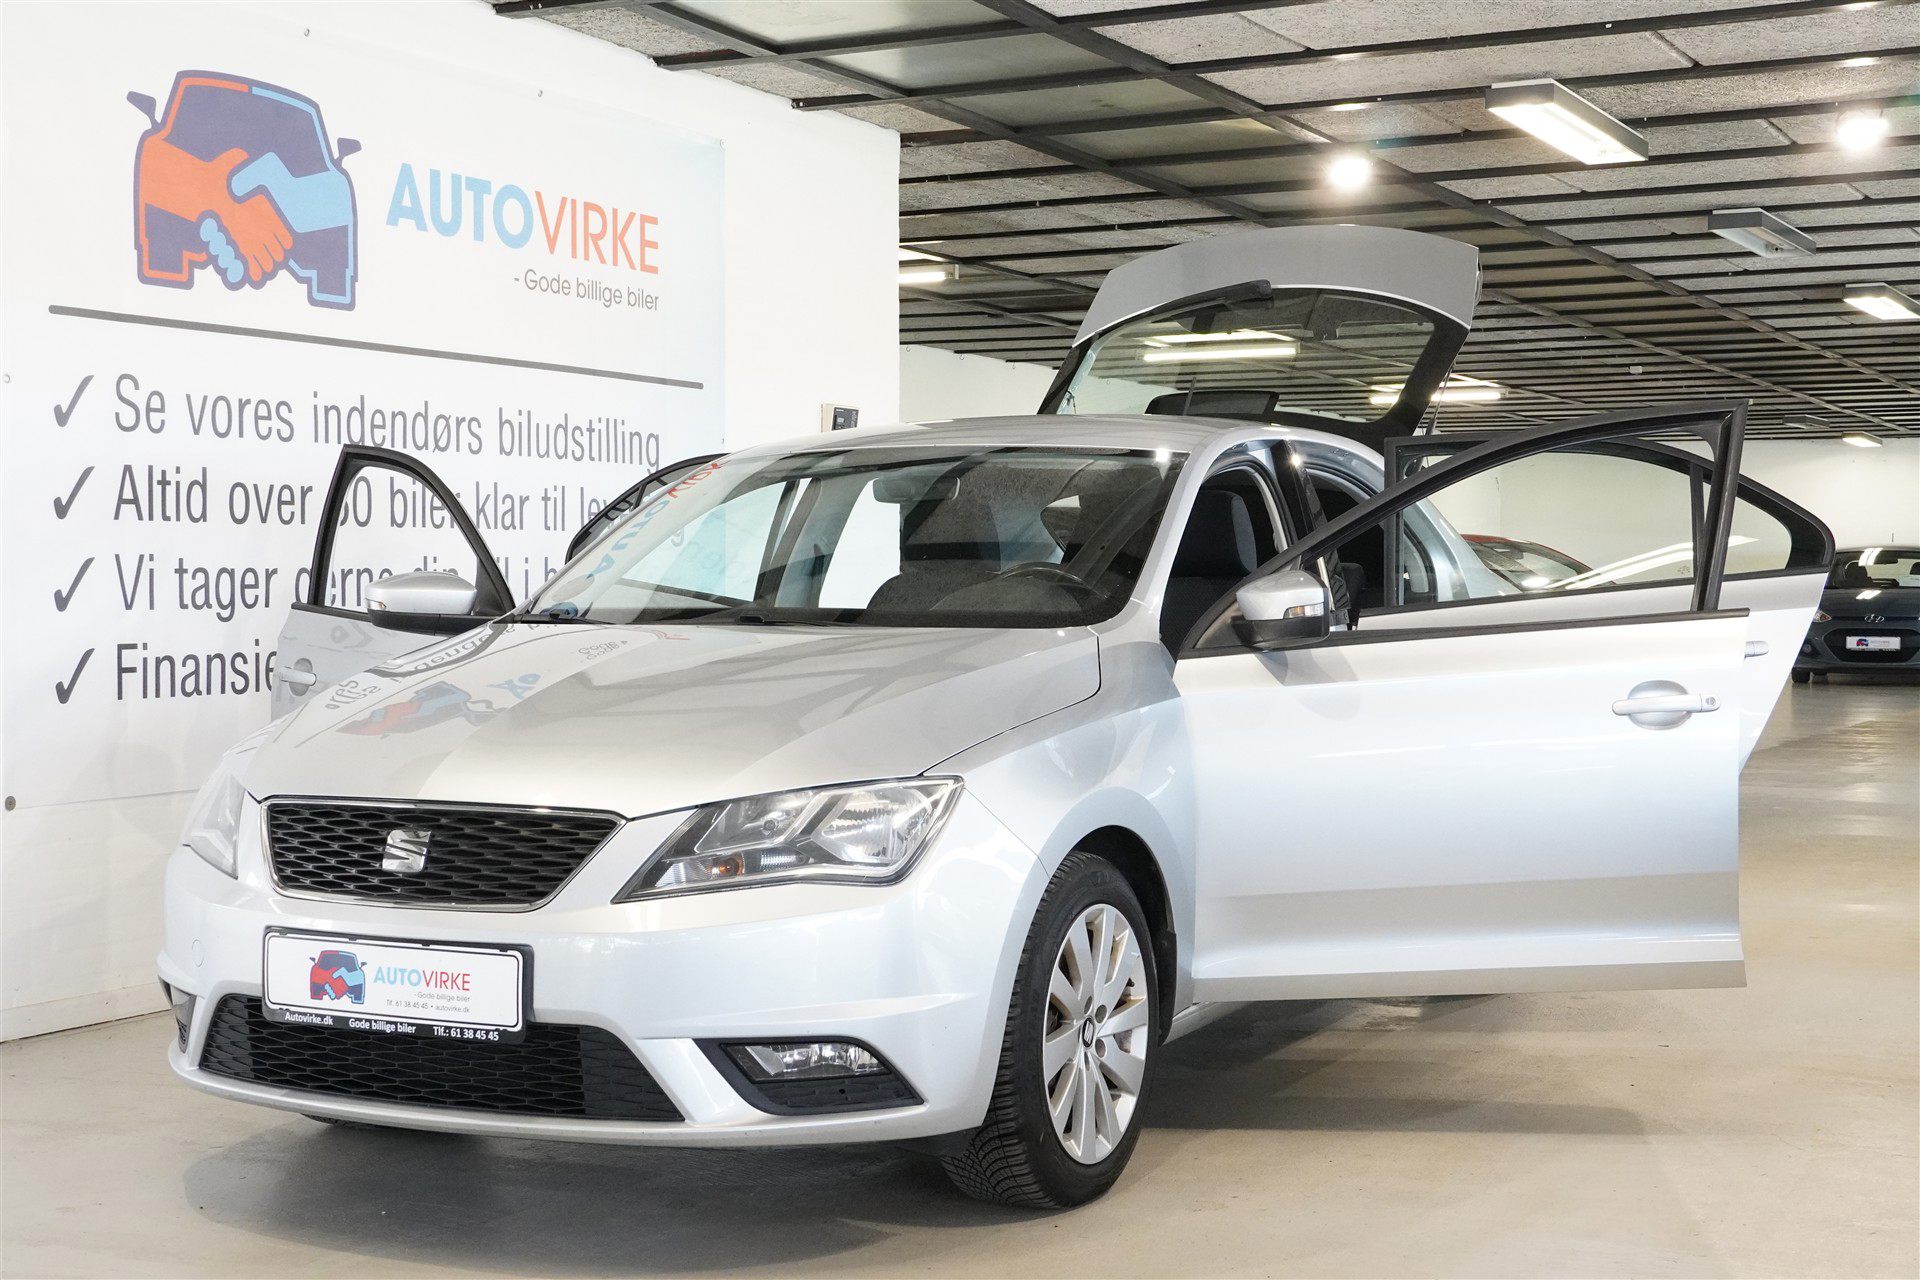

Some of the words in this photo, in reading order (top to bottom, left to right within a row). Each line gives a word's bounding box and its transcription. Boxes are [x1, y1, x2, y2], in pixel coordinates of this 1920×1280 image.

[385, 162, 659, 275] AUTOVIRKE
[524, 268, 572, 296] Gode
[576, 276, 623, 308] billige
[627, 286, 660, 311] biler
[114, 373, 167, 433] Se
[185, 393, 296, 443] vores
[312, 390, 484, 455] indendørs
[498, 406, 660, 476] biludstilling
[113, 464, 208, 524] Altid
[228, 481, 314, 526] over
[339, 475, 373, 528] 0
[475, 480, 530, 532] klar
[541, 484, 566, 532] til
[114, 553, 155, 611] Vi
[173, 557, 279, 623] tager
[373, 965, 471, 992] AUTOVIRKE
[284, 1011, 334, 1026] Autovirke.dk
[349, 1018, 370, 1030] Gode
[371, 1019, 396, 1033] billige
[397, 1022, 417, 1034] biler
[432, 1026, 449, 1037] Tlf.:
[450, 1027, 462, 1039] 61
[462, 1029, 474, 1040] 38
[475, 1030, 487, 1041] 45
[487, 1031, 499, 1042] 45
